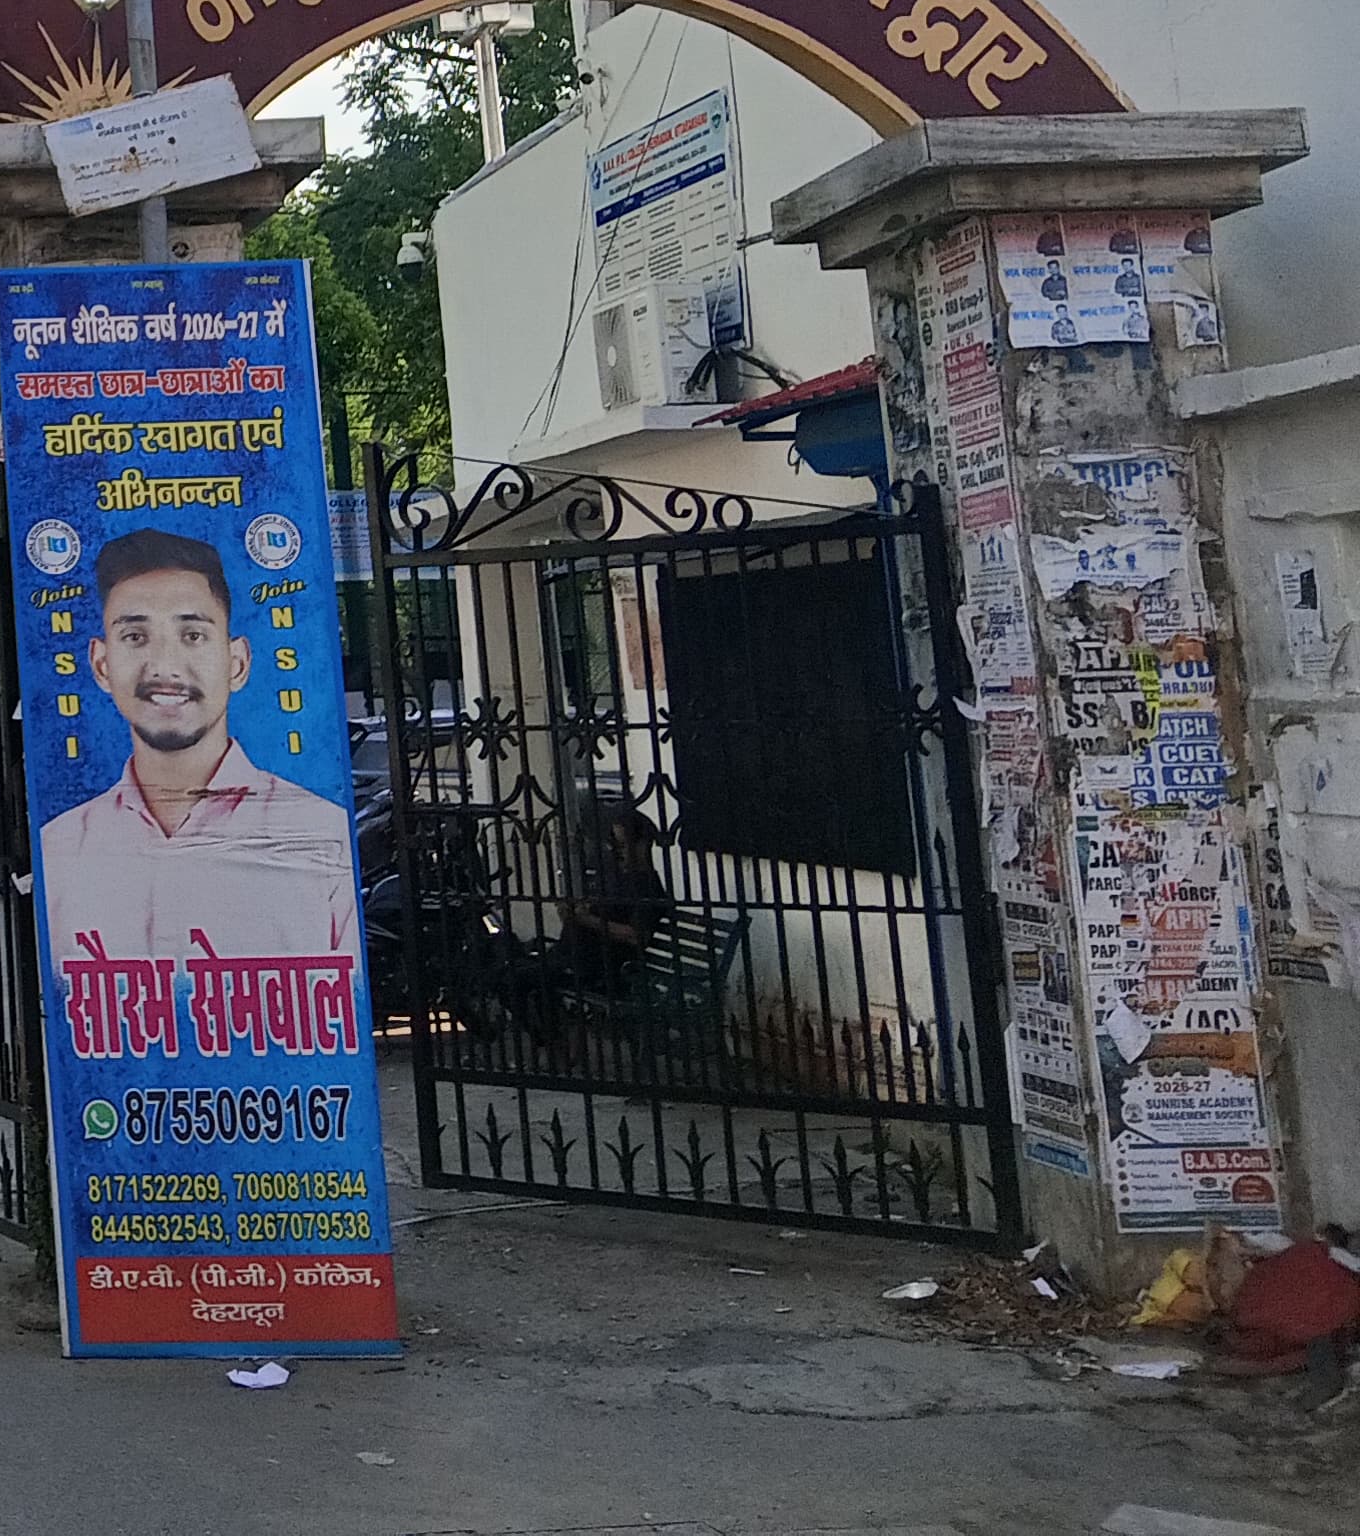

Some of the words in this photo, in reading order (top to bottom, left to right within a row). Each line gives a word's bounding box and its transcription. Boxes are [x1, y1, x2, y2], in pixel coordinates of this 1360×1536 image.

[13, 317, 66, 360] नूतन
[145, 302, 176, 342] वर्ष
[264, 299, 286, 338] में
[16, 369, 94, 400] समस्त
[248, 364, 284, 392] का
[43, 414, 133, 457] हार्दिक
[139, 420, 236, 453] स्वागत
[240, 406, 283, 451] एवं
[96, 469, 242, 511] अभिनन्दन
[31, 583, 84, 609] Join
[250, 577, 307, 604] Join
[1161, 744, 1219, 763] CUET
[1173, 766, 1218, 785] CAT
[61, 929, 180, 1057] सौरभ
[186, 928, 360, 1056] सेमवाल
[124, 1086, 351, 1144] 8755069167
[1199, 1096, 1253, 1109] ACADEMY
[88, 1174, 227, 1205] 8171522269,
[233, 1171, 367, 1201] 7060818544
[91, 1213, 231, 1245] 8445632543,
[237, 1211, 371, 1241] 8267079538
[190, 1299, 285, 1327] देहरादून
